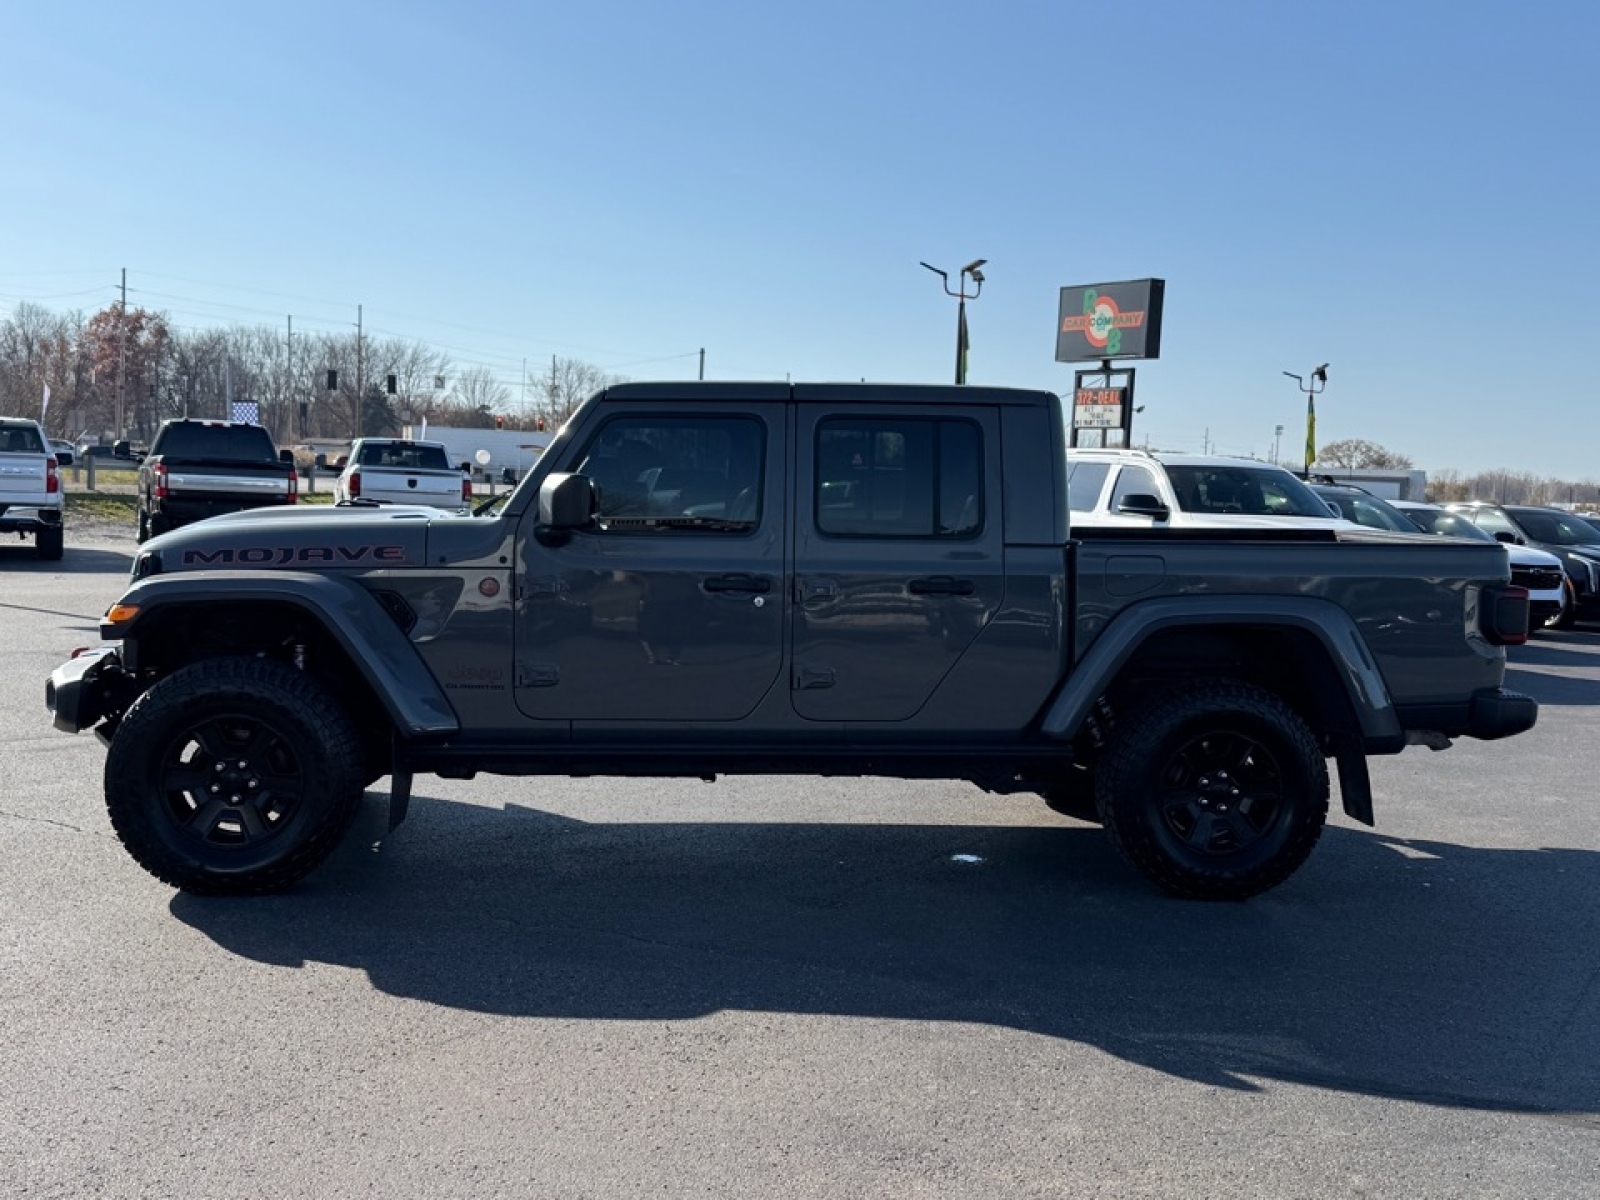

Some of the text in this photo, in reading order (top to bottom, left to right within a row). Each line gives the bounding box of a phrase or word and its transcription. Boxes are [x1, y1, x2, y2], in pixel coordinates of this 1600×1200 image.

[1090, 314, 1142, 328] COMPANY
[1106, 329, 1122, 354] B
[182, 546, 405, 565] MOJAVE
